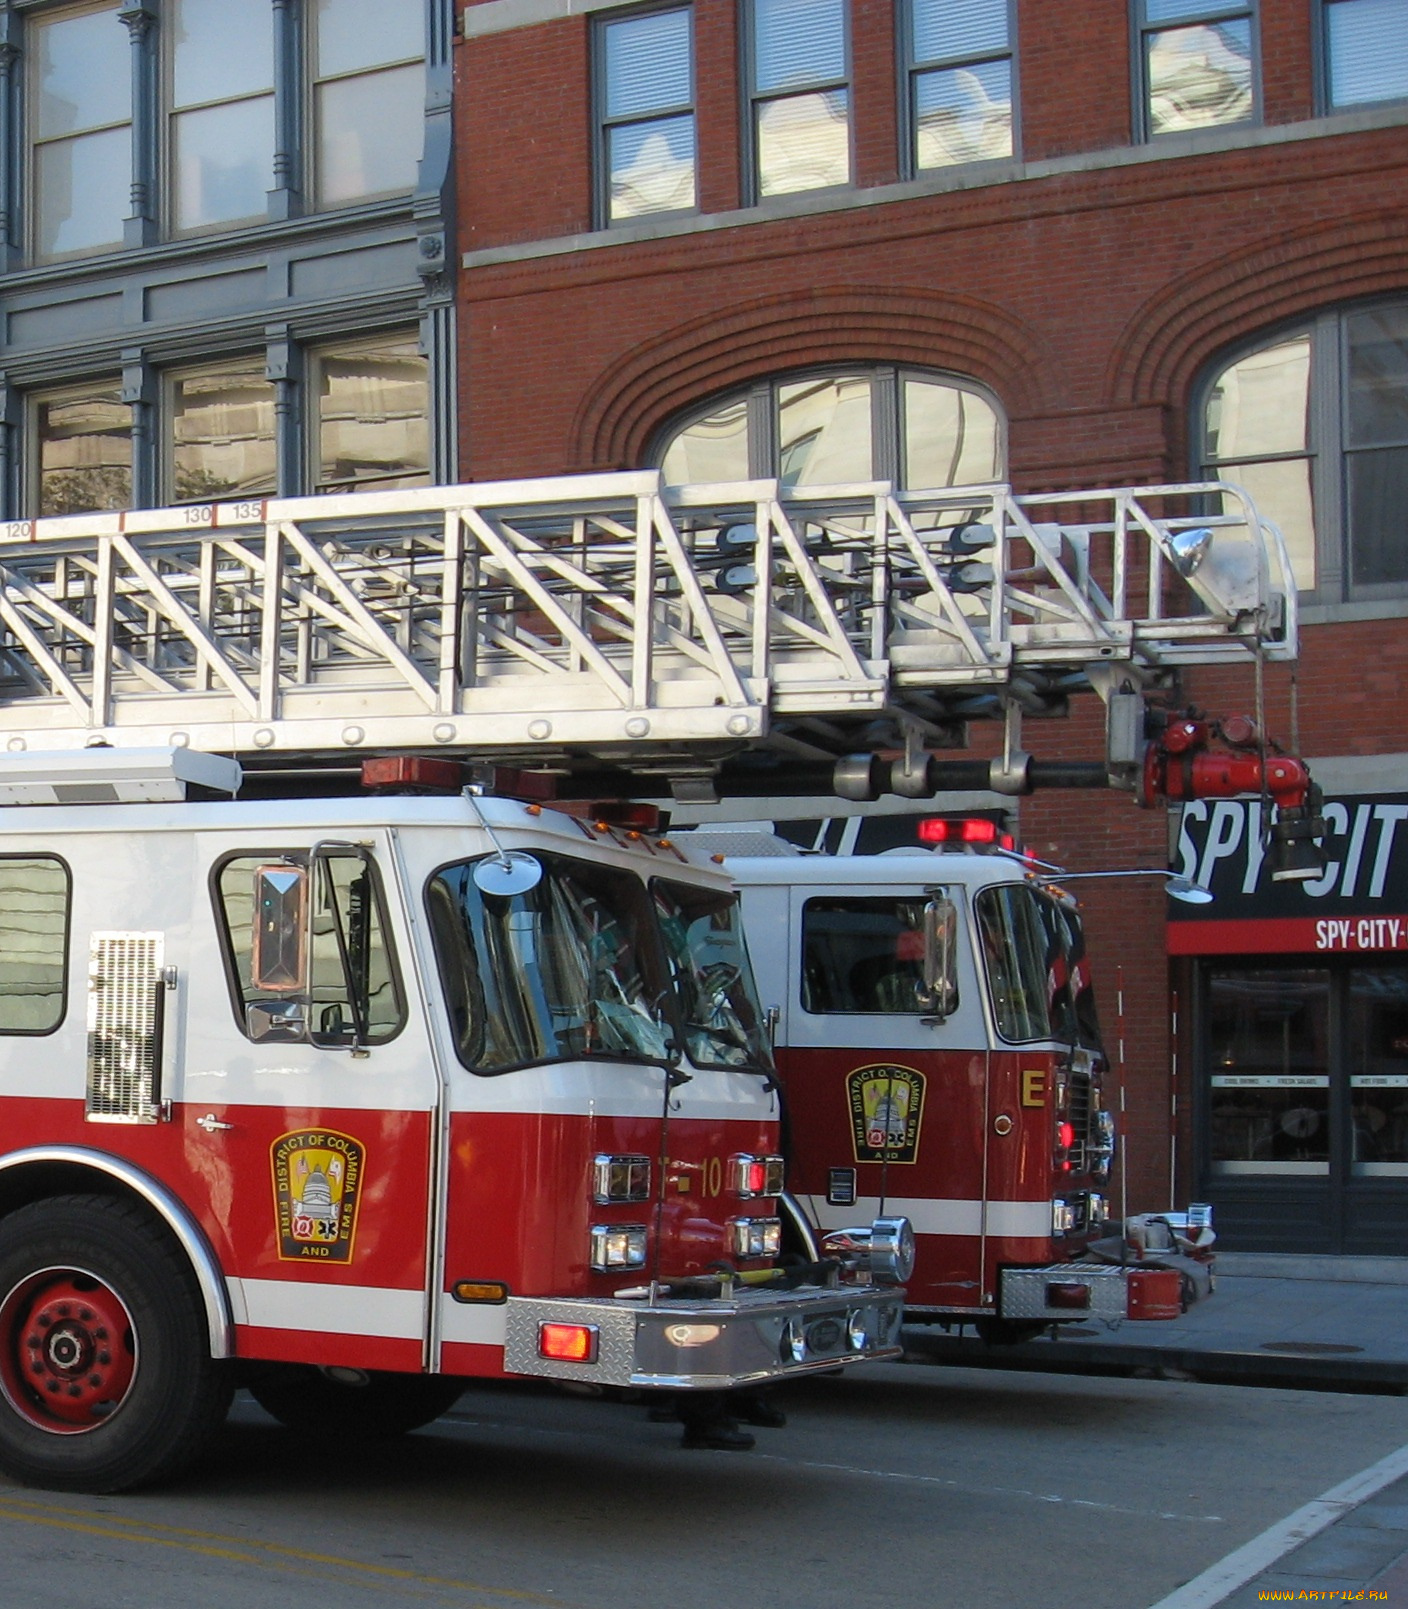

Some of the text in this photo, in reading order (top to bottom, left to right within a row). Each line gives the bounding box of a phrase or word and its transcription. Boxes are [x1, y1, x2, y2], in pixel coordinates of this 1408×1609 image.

[183, 507, 212, 523] 130
[233, 504, 262, 520] 135
[6, 522, 31, 538] 120
[1023, 1070, 1045, 1107] E
[276, 1134, 359, 1193] DISTRICT OF COLUMBIA
[280, 1201, 353, 1257] FIRE AND EMS
